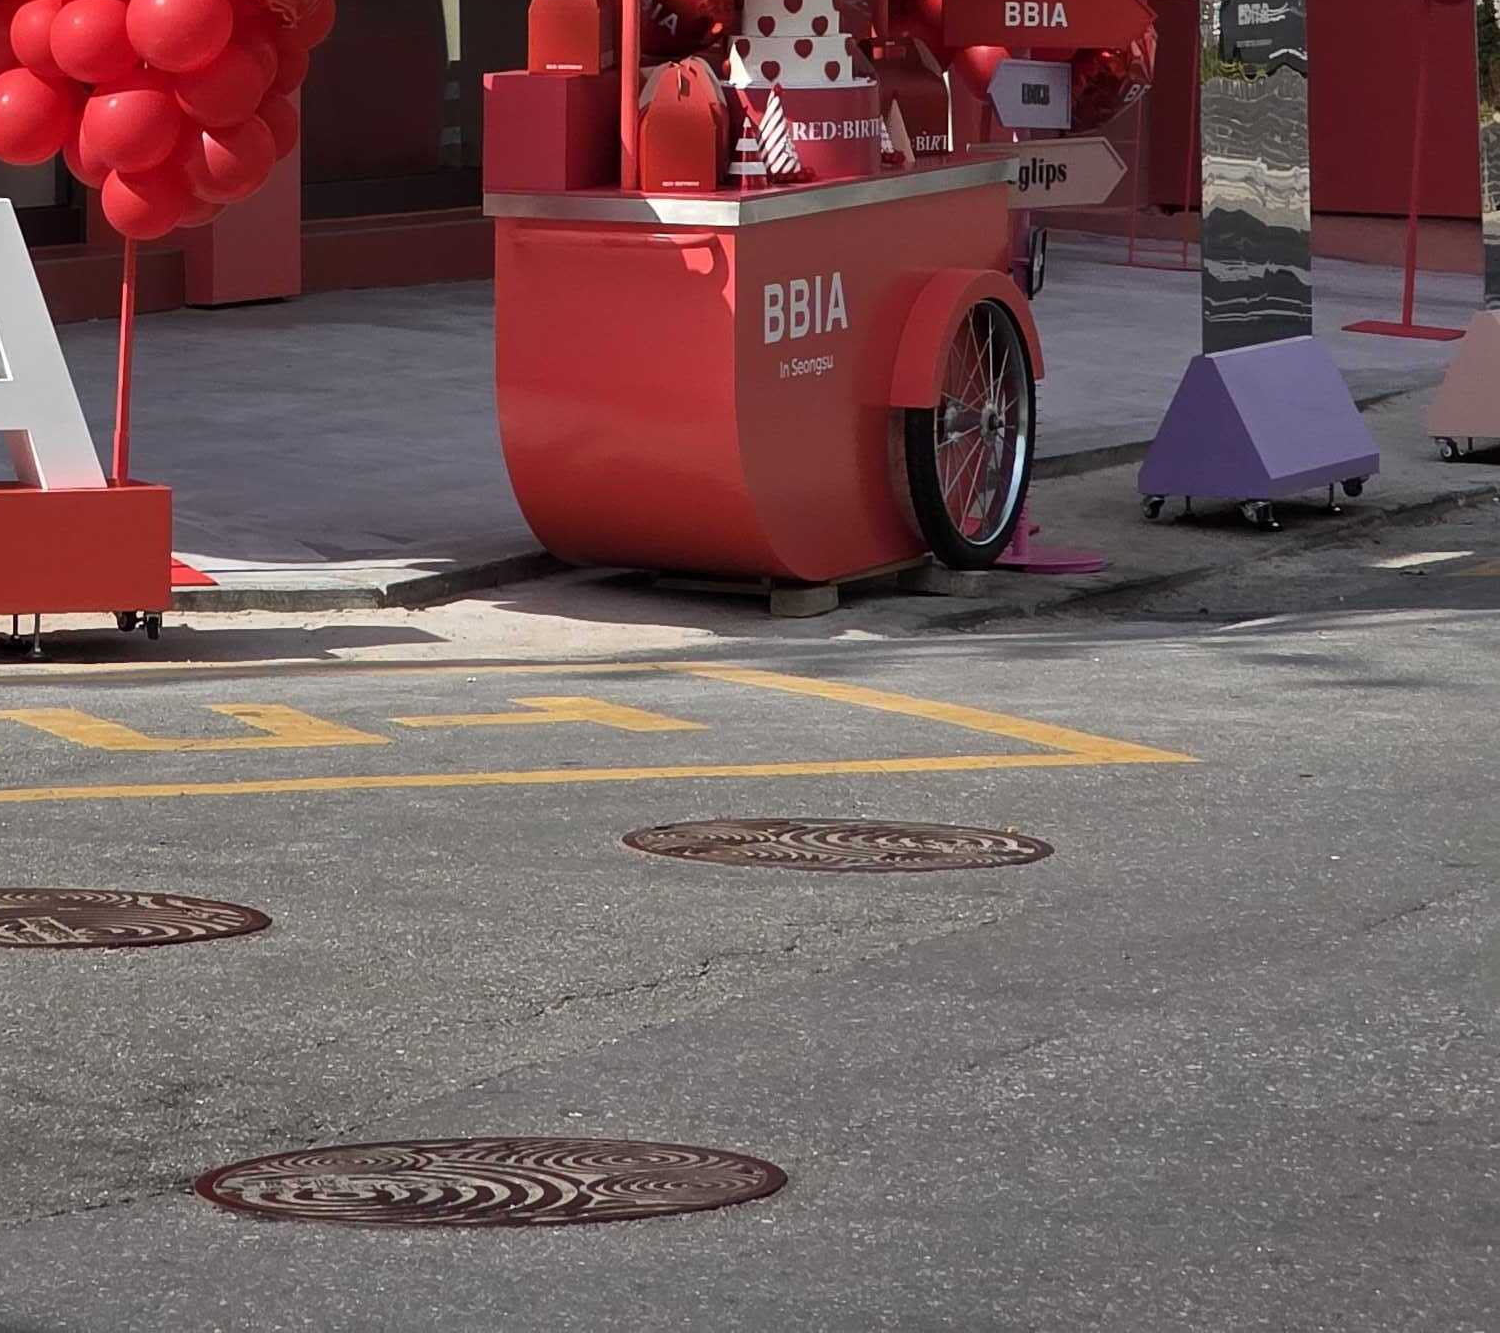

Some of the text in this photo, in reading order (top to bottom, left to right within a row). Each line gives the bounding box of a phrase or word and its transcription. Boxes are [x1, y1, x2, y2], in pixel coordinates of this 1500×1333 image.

[1004, 1, 1068, 27] BBIA
[1007, 157, 1067, 192] glips
[764, 271, 848, 344] BBIA
[791, 354, 834, 376] Seongsu
